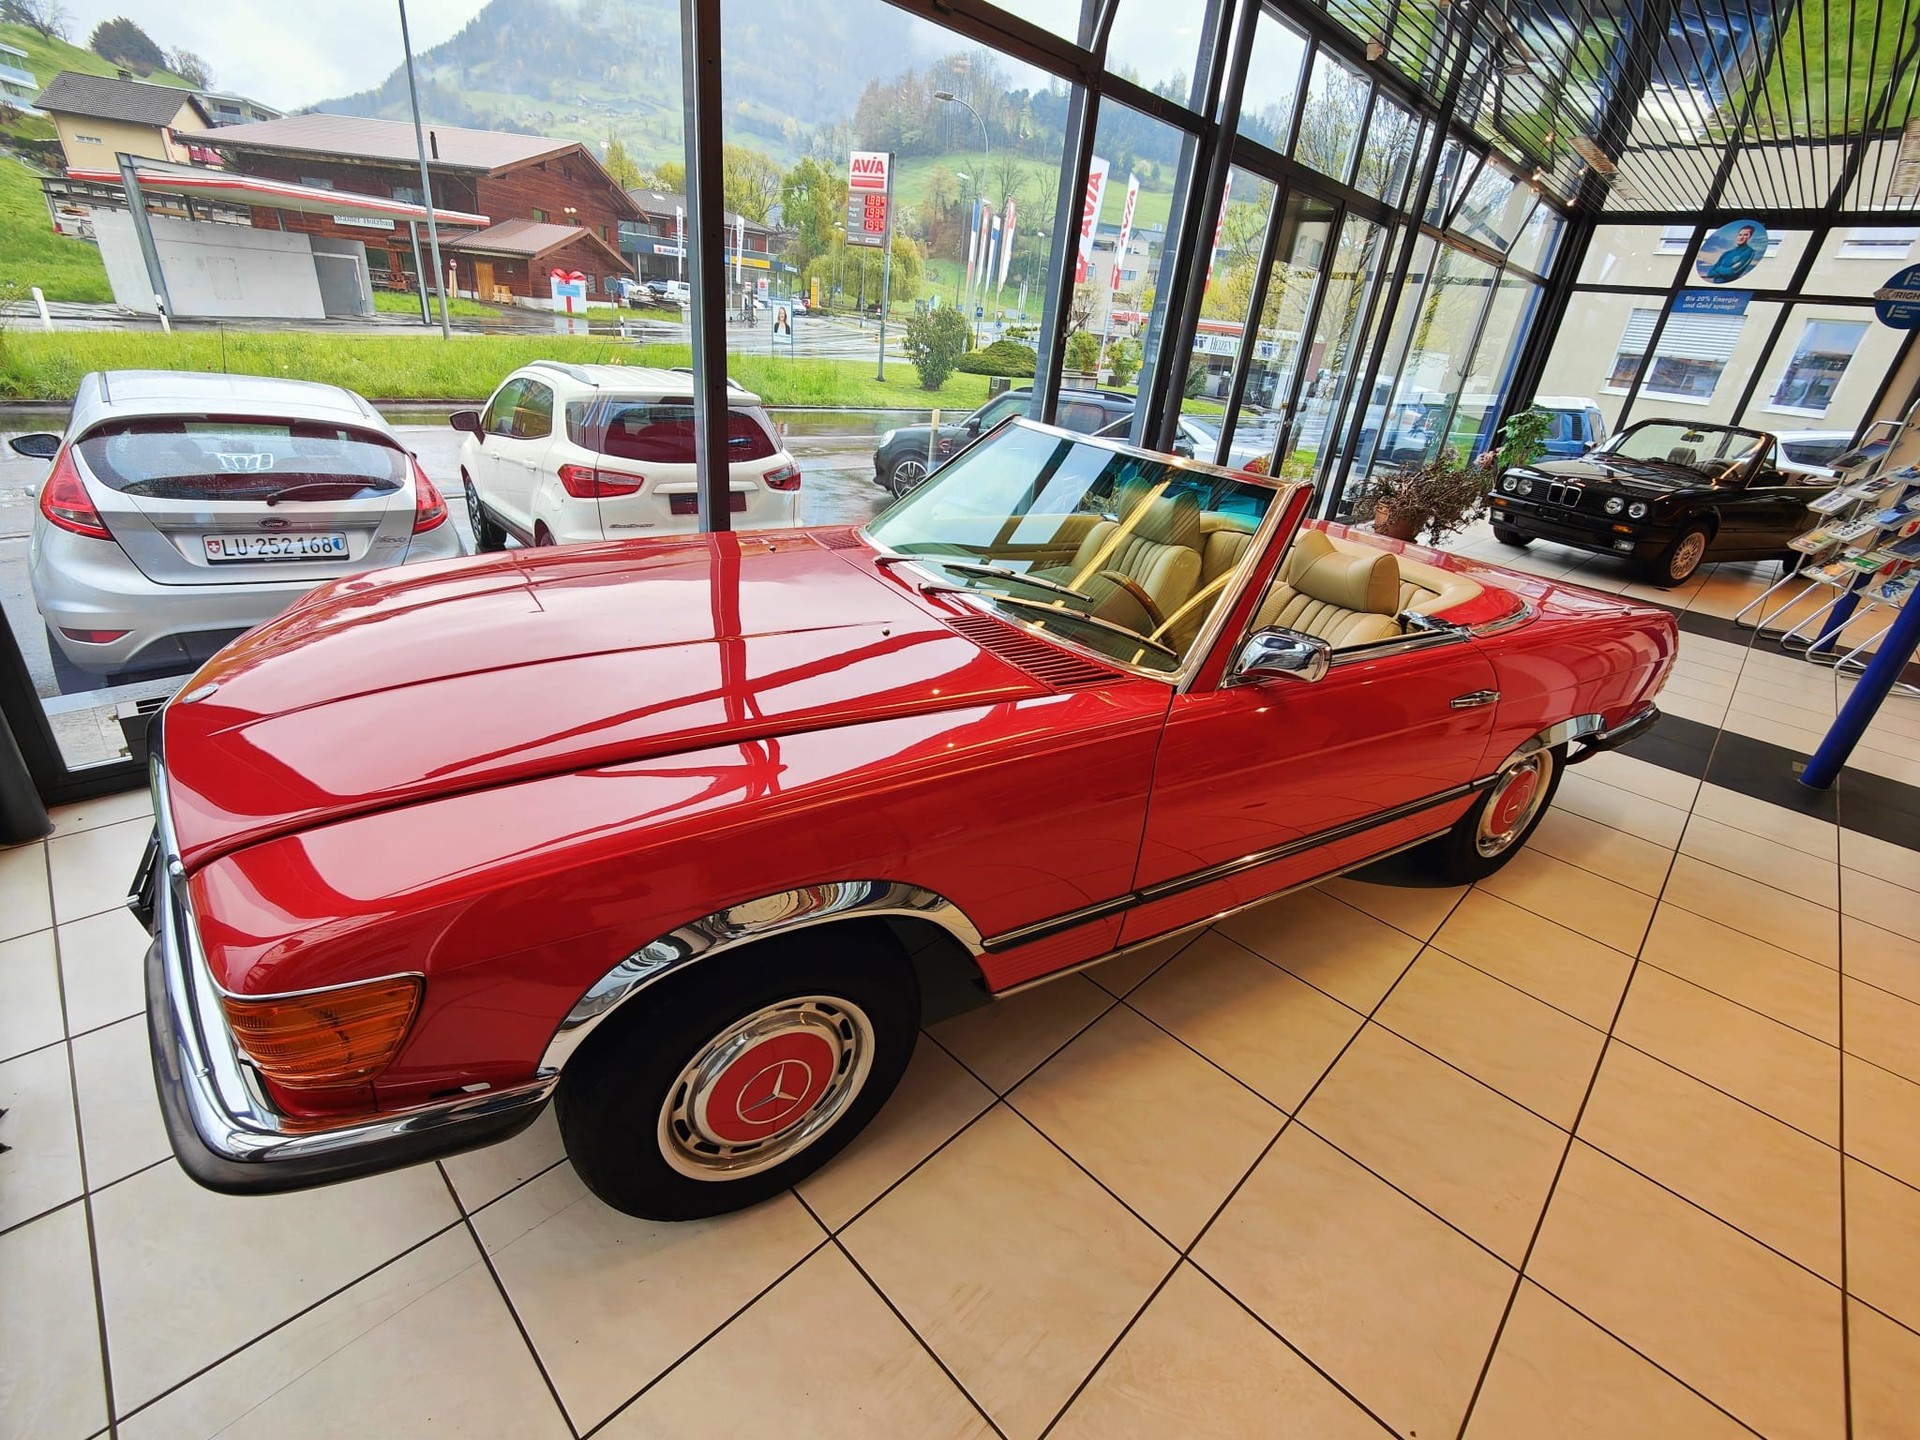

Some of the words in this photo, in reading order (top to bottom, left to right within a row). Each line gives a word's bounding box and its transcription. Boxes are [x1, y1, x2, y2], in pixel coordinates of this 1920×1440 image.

[851, 156, 885, 174] AVIA
[1080, 171, 1103, 239] AVIA
[1712, 296, 1740, 304] Energie
